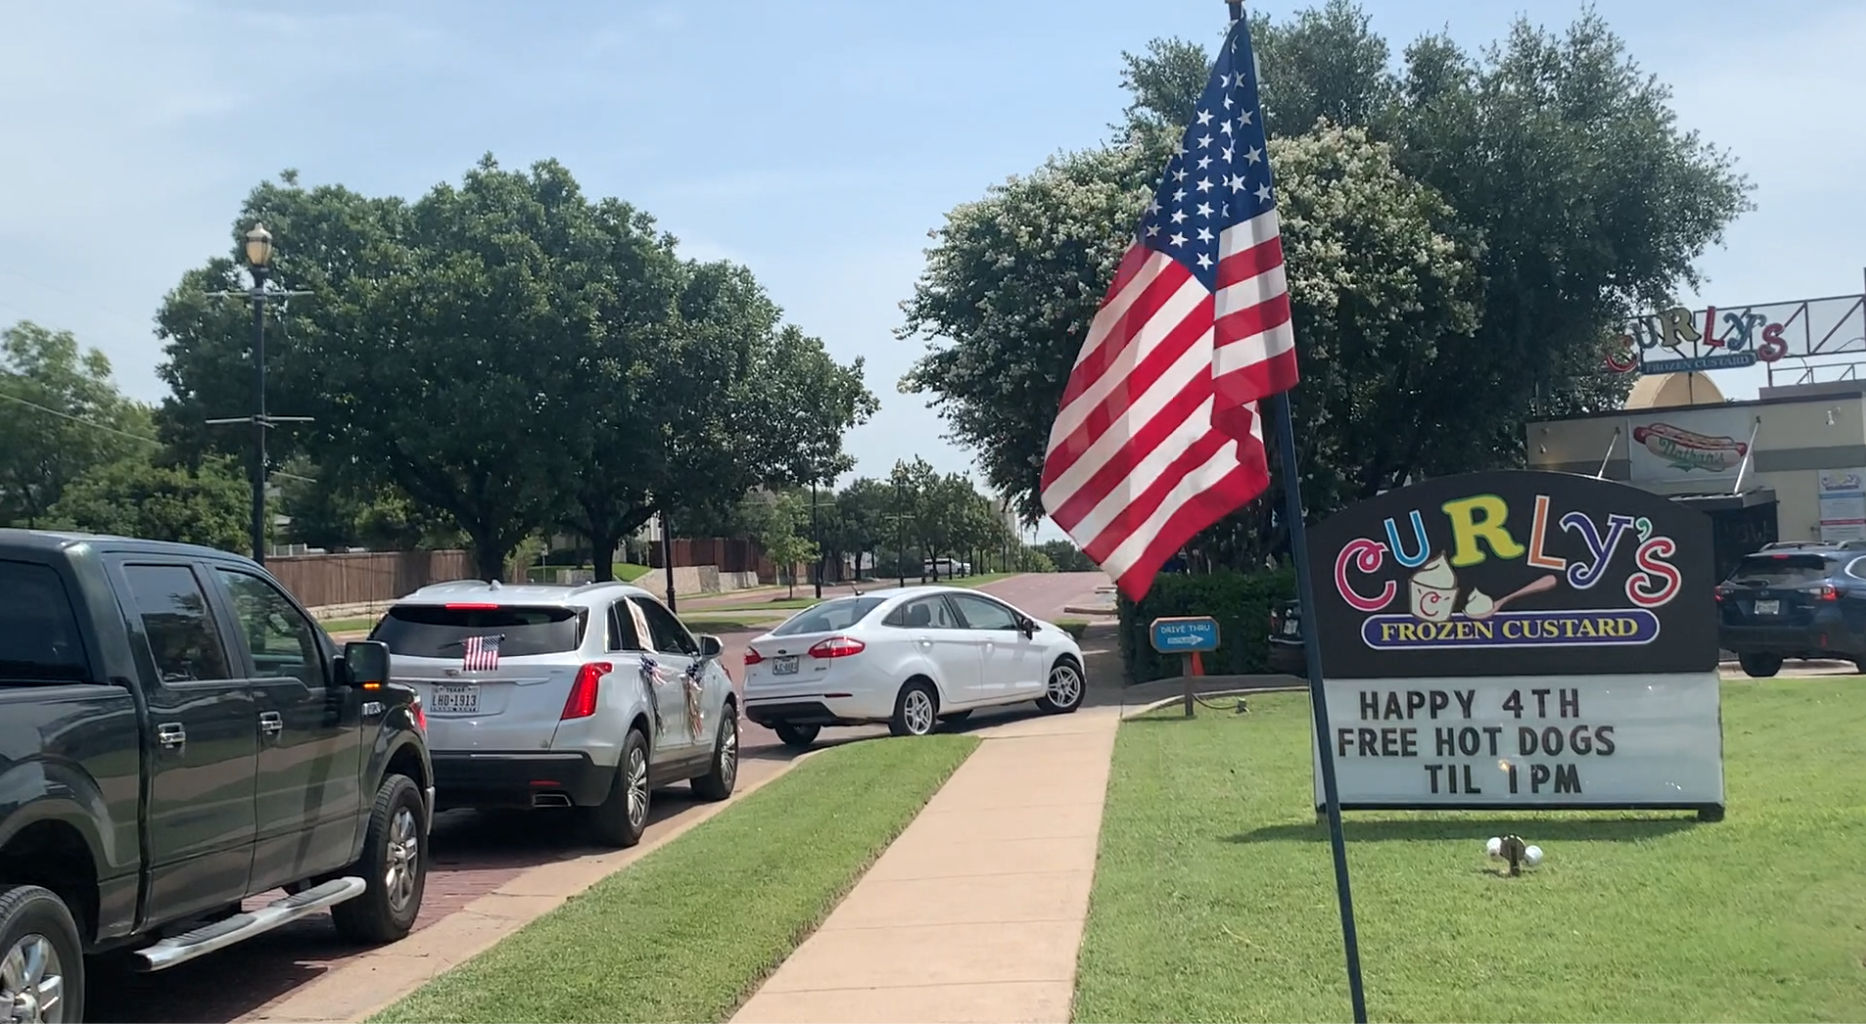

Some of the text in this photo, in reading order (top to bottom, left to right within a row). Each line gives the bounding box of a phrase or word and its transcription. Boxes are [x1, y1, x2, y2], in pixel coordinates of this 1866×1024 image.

[1694, 355, 1750, 369] CUSTARD
[1334, 493, 1682, 611] CURLY'S
[1160, 624, 1210, 634] DRIVE THRU
[1380, 617, 1638, 642] FROZEN CUSTARD
[1359, 688, 1580, 720] HAPPY 4TH
[1338, 725, 1615, 757] FREE HOT DOGS
[1424, 764, 1482, 794] TIL
